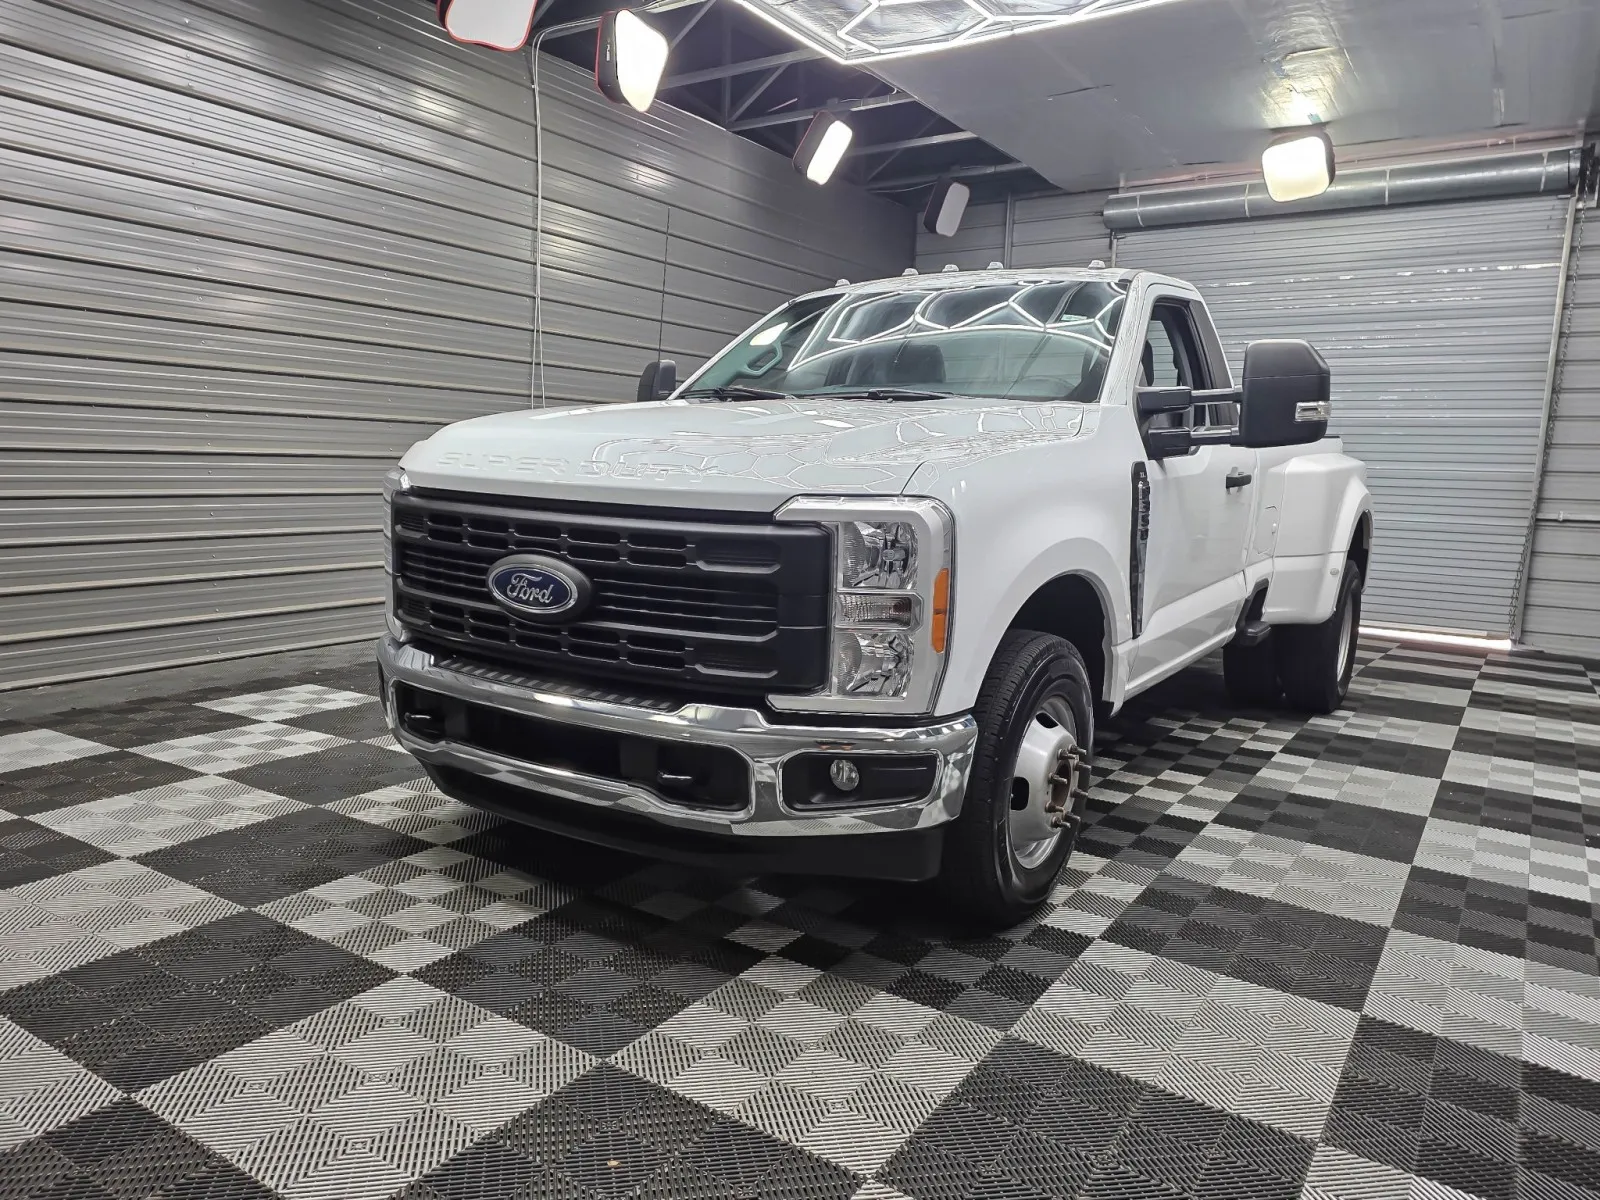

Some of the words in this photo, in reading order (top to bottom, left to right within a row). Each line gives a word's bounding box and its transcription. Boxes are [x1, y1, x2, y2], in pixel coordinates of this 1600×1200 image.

[435, 451, 569, 476] SUPER
[575, 460, 719, 483] DUTY
[506, 573, 554, 604] Ford
